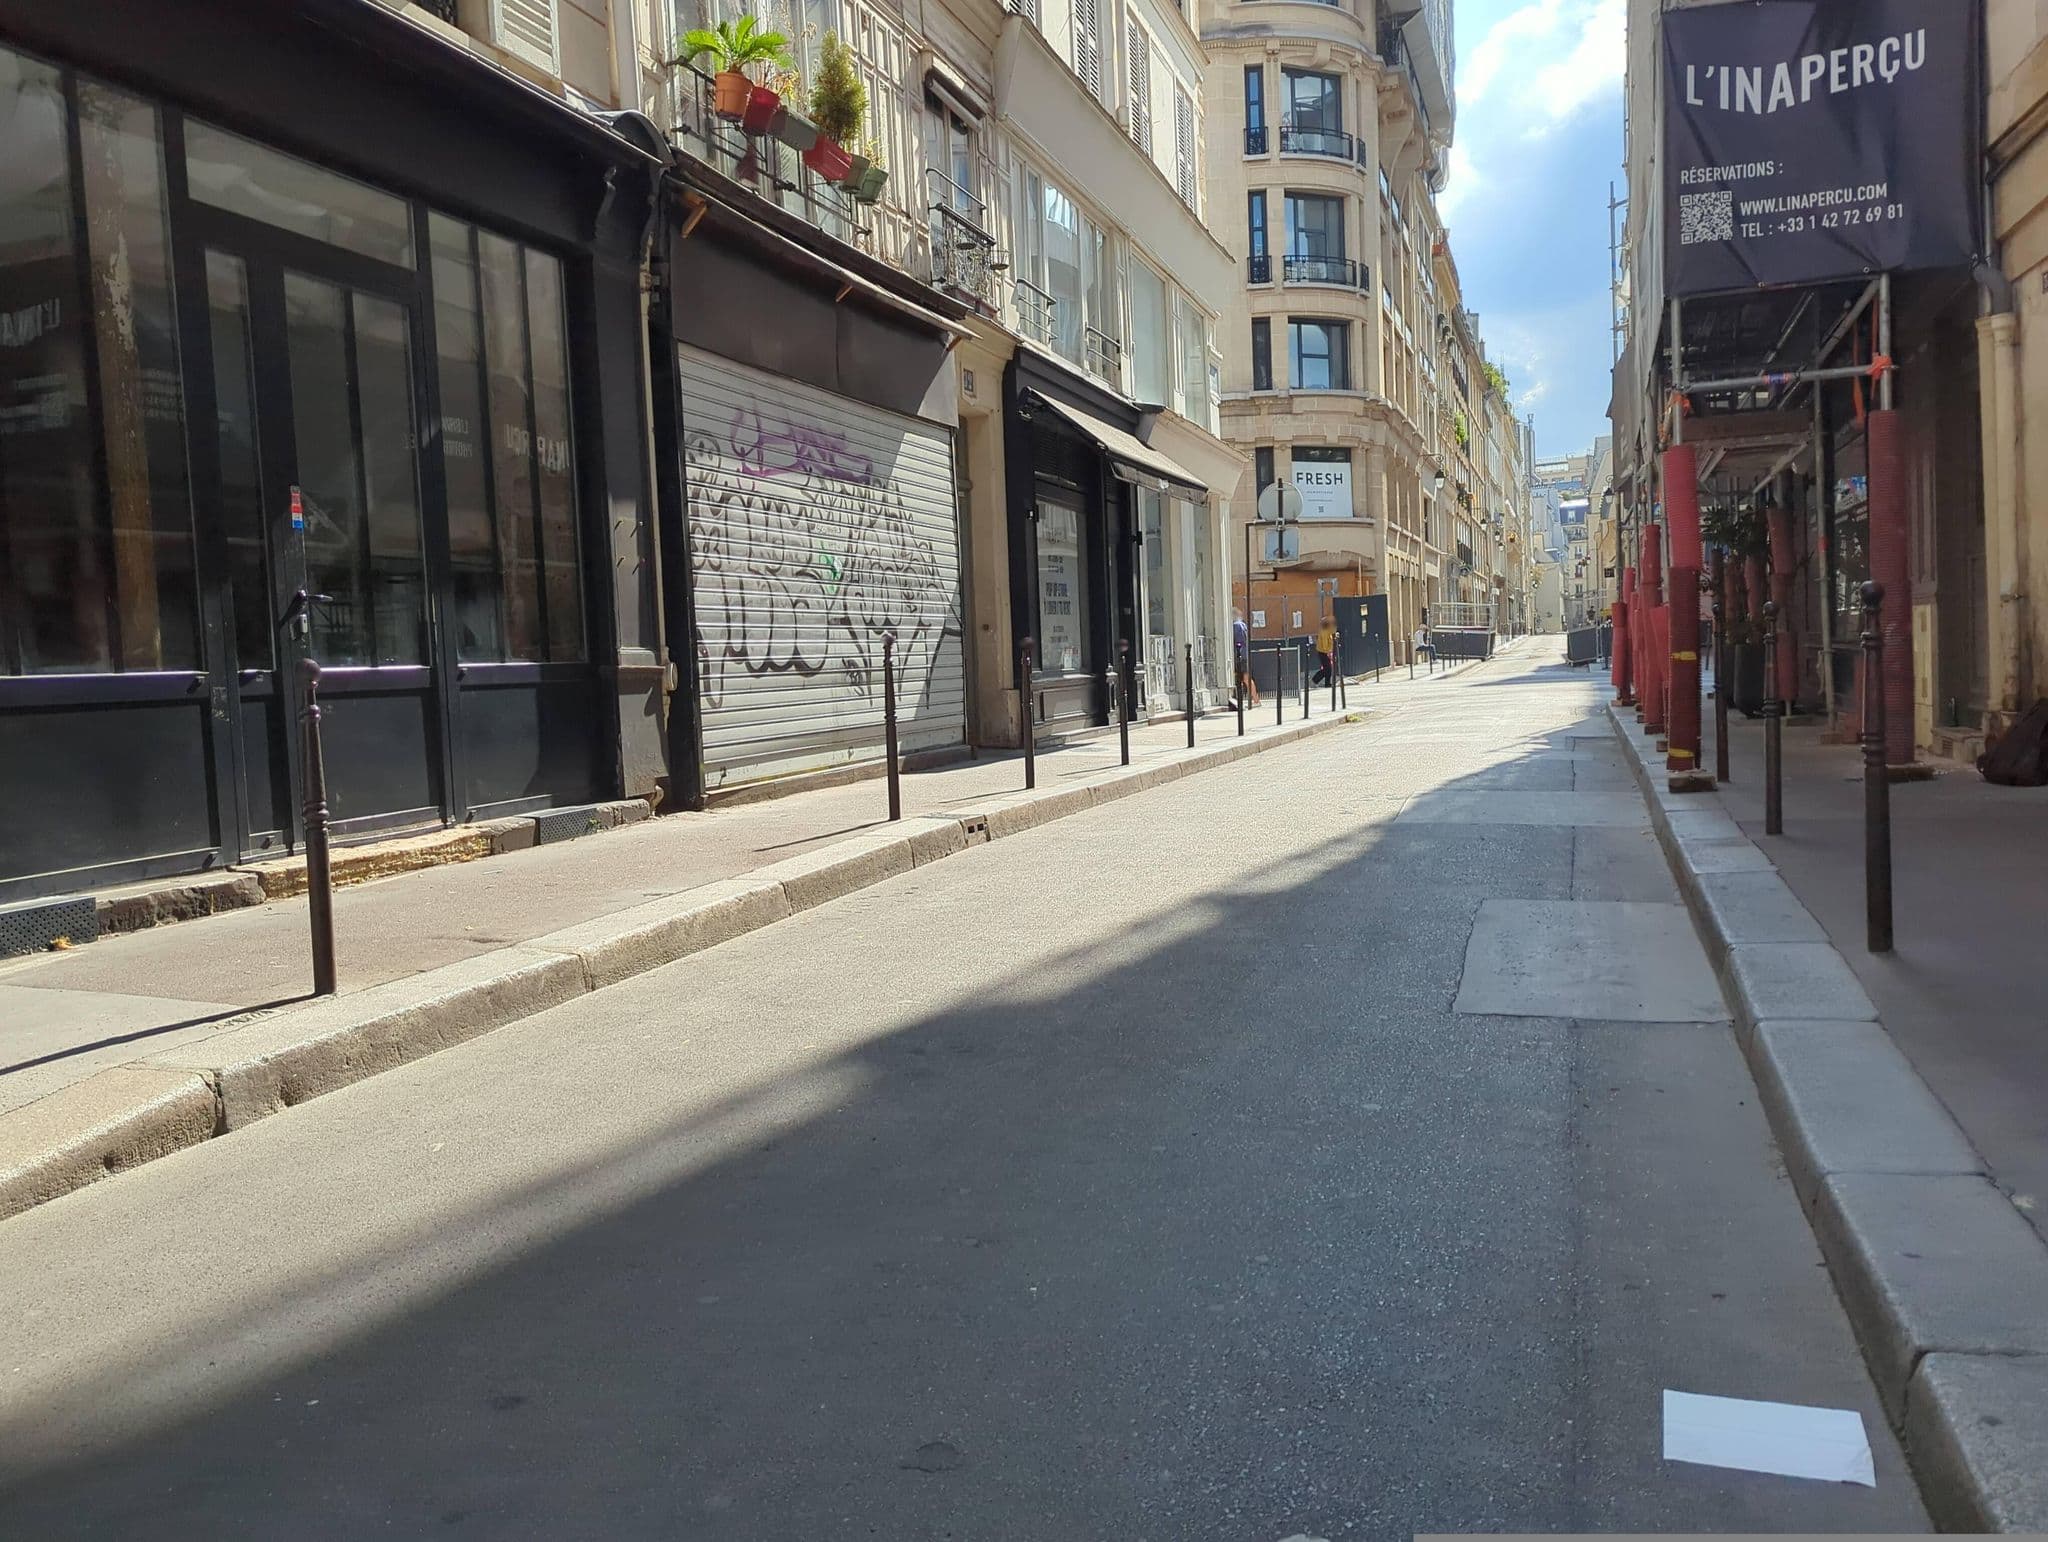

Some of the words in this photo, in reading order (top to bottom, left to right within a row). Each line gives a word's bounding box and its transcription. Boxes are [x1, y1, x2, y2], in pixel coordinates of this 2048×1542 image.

[1686, 28, 1926, 115] L'INAPERÇU
[1680, 160, 1775, 185] RÉSERVATIONS
[1739, 182, 1888, 217] WWW.LINAPERCU.COM
[1740, 222, 1765, 238] TEL
[1777, 217, 1804, 233] +33
[1808, 215, 1816, 230] 1
[1821, 212, 1839, 228] 42
[1843, 209, 1861, 226] 72
[1865, 206, 1883, 223] 69
[1887, 203, 1904, 220] 81
[1296, 472, 1343, 486] FRESH
